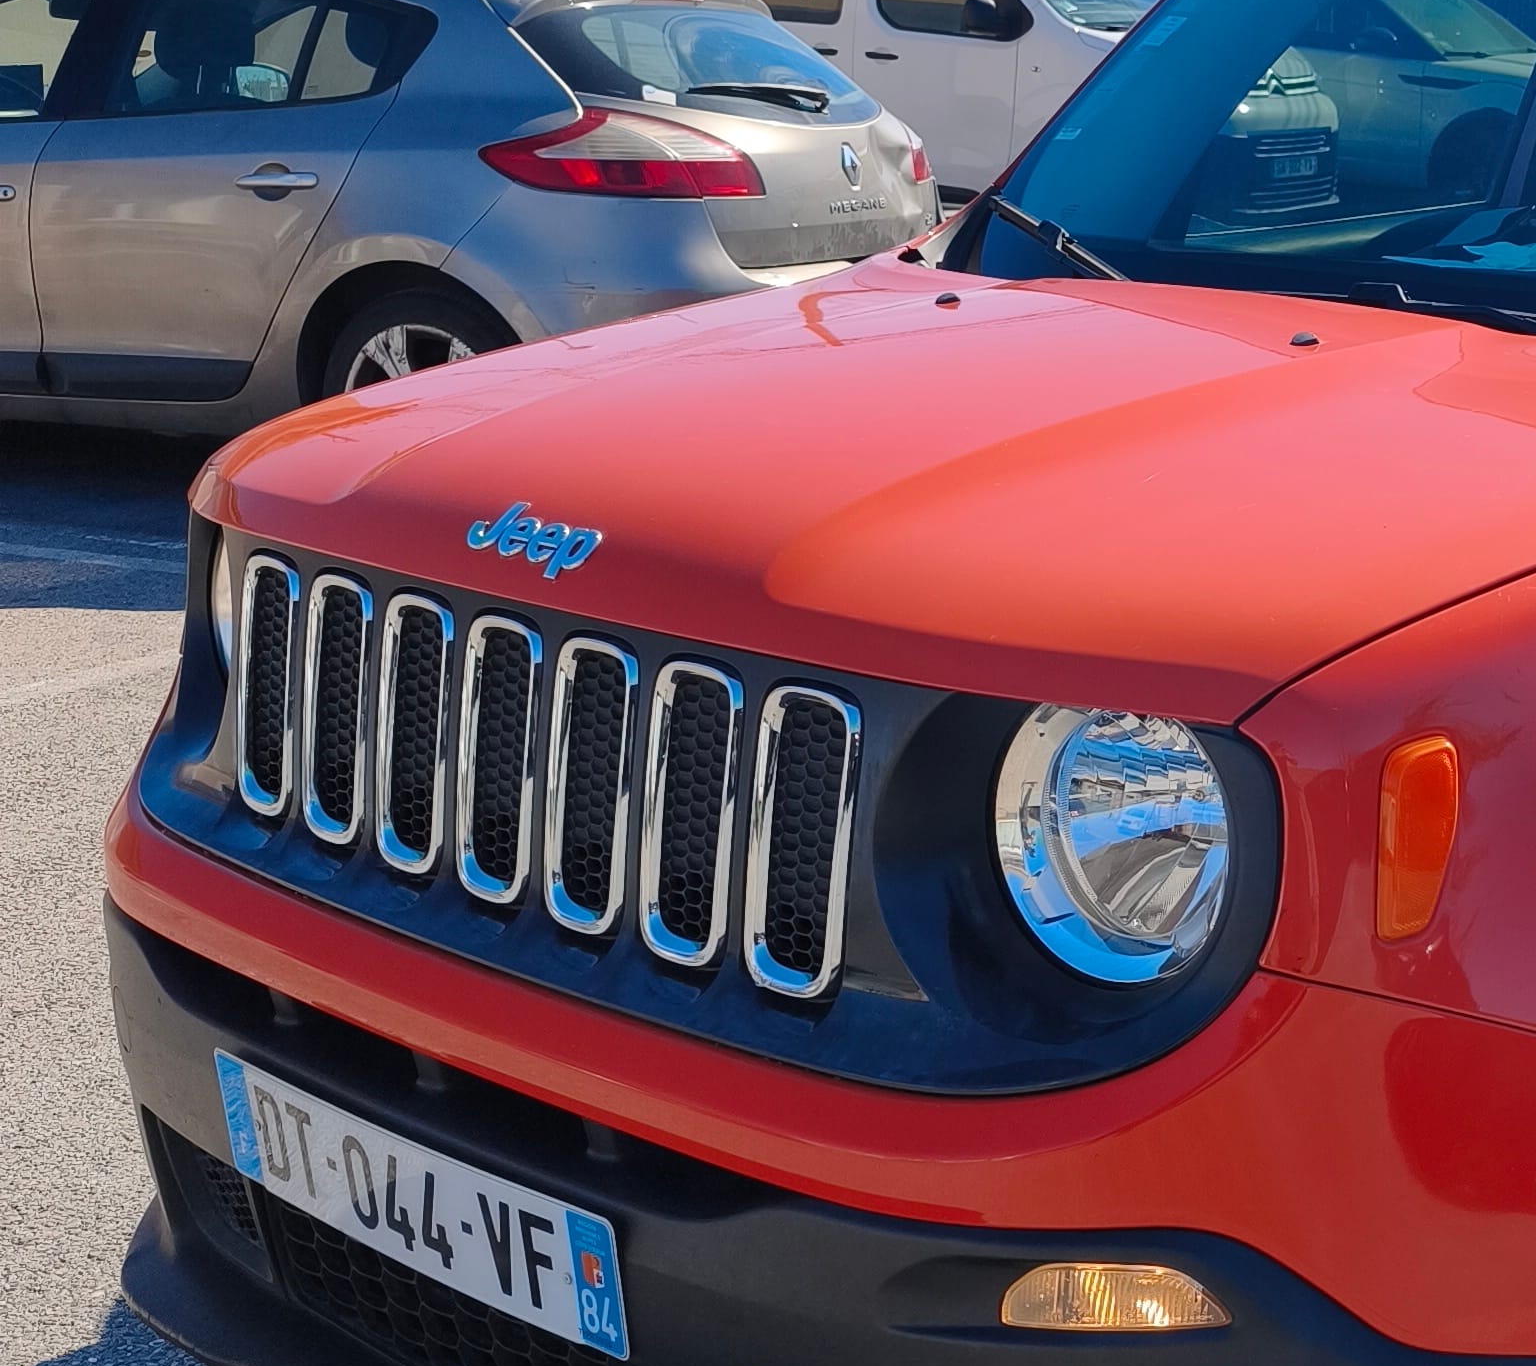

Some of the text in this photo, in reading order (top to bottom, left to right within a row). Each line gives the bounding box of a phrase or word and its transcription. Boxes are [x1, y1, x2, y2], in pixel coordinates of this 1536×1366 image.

[829, 197, 888, 215] MEGANE
[466, 501, 604, 580] Jeep
[253, 1084, 555, 1310] DT-044-VF
[581, 1288, 619, 1343] 84
